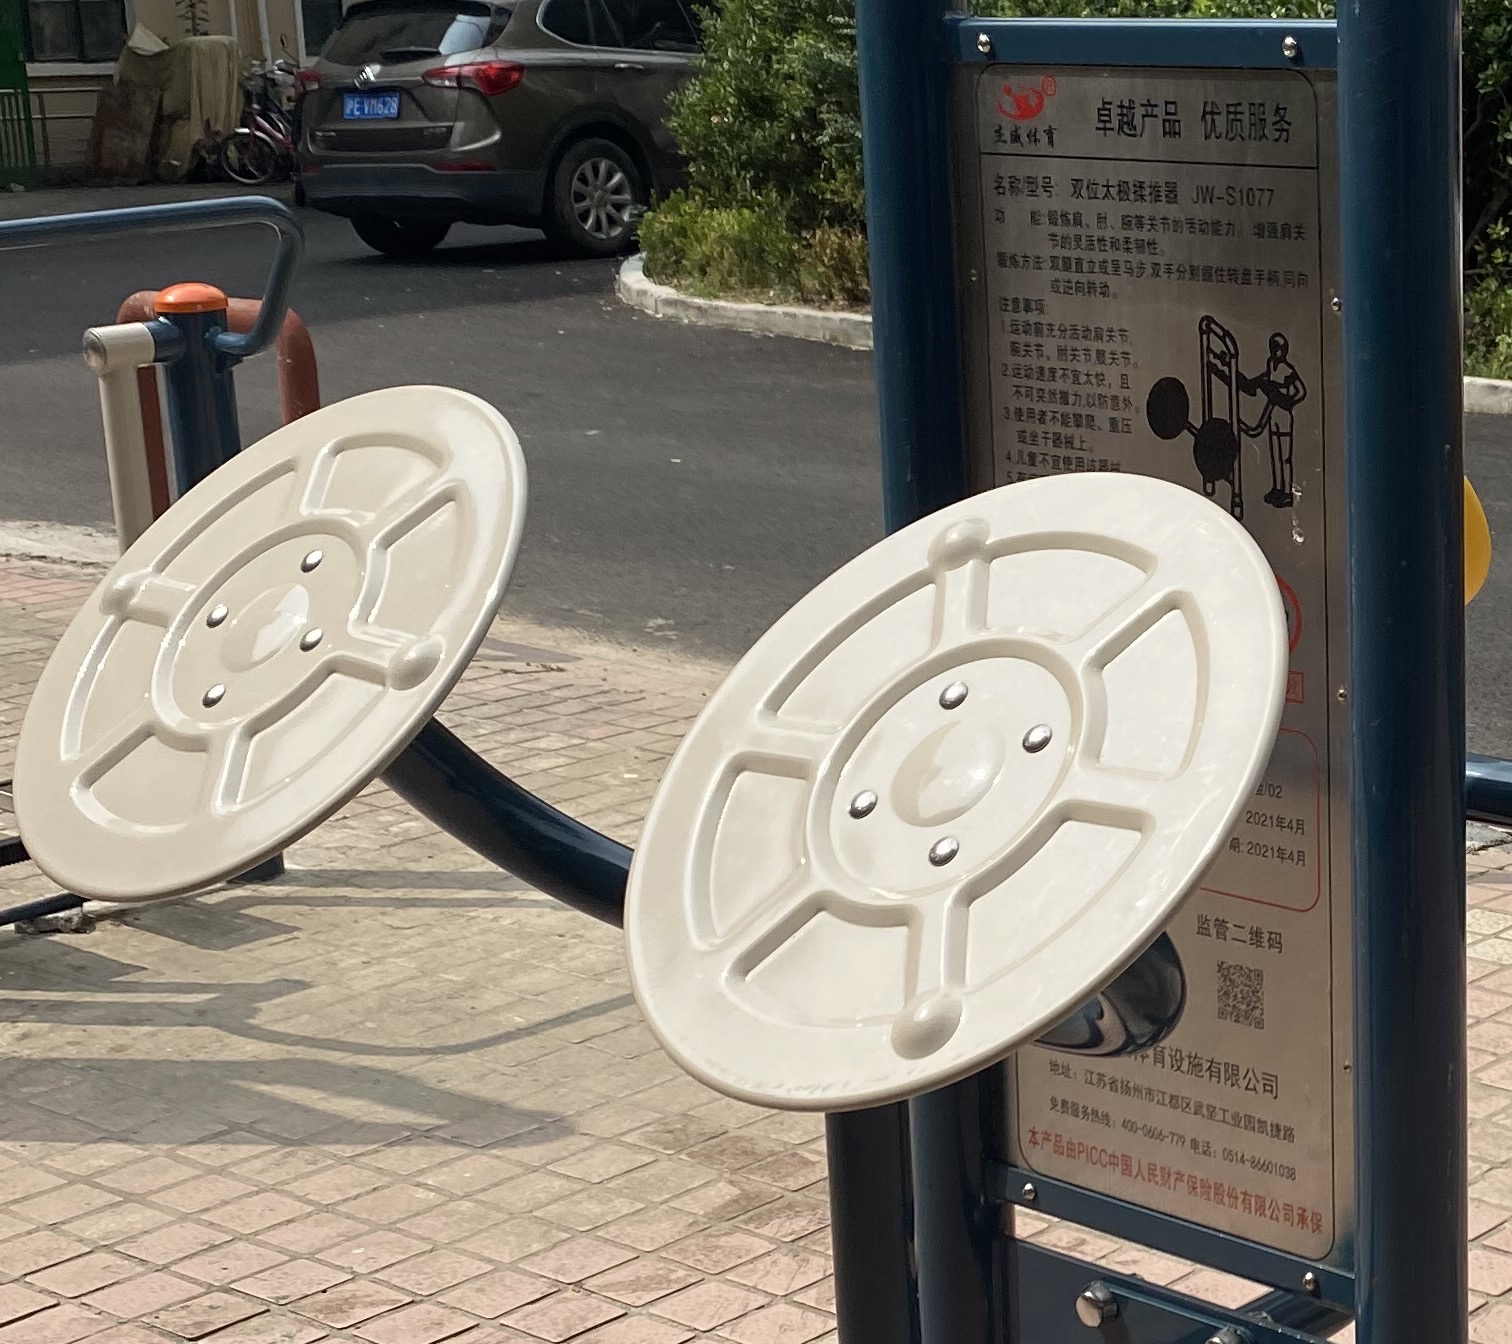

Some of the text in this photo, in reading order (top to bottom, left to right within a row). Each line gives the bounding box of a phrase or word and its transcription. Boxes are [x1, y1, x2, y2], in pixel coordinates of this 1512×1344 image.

[1095, 98, 1292, 144] 卓越产品 优质服务
[1192, 185, 1275, 208] JW-S1077
[1246, 809, 1305, 836] 2021年4月
[1196, 913, 1283, 954] 监管二维码
[1028, 1125, 1324, 1235] 本产品由PICC中国人民财产保险股份有限公司承保
